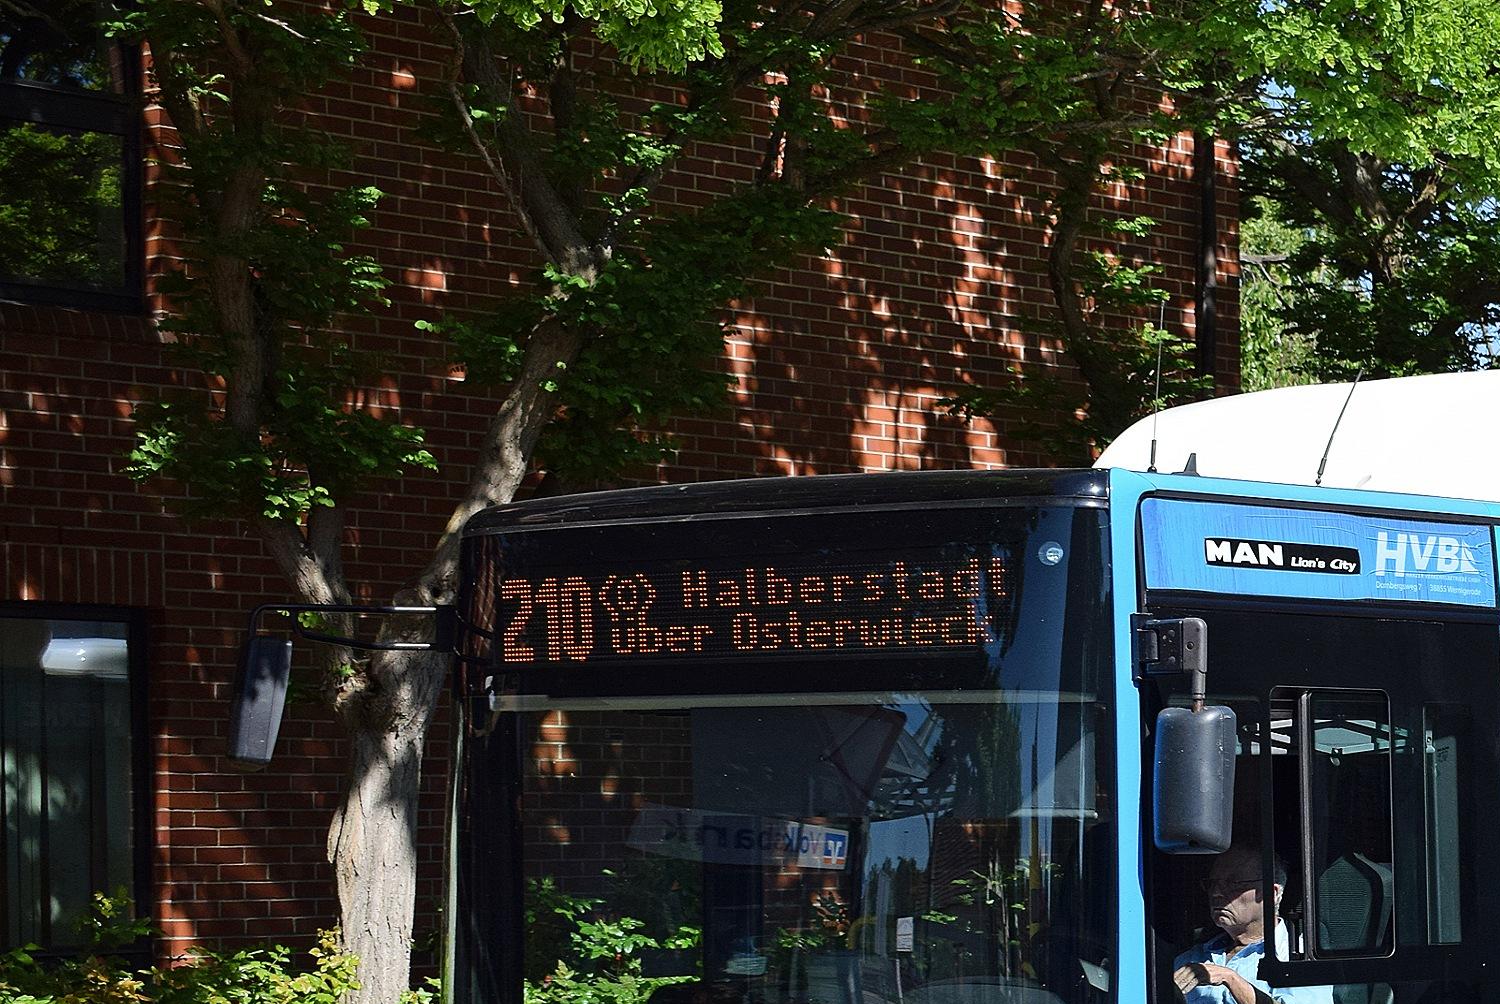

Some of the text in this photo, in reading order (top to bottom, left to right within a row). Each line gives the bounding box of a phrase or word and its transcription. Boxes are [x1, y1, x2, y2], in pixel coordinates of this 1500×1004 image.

[1205, 539, 1284, 567] MAN
[1290, 556, 1357, 573] Lion's City
[1376, 531, 1462, 577] HVB
[683, 557, 1006, 608] Halberstadt
[501, 576, 594, 662] 210
